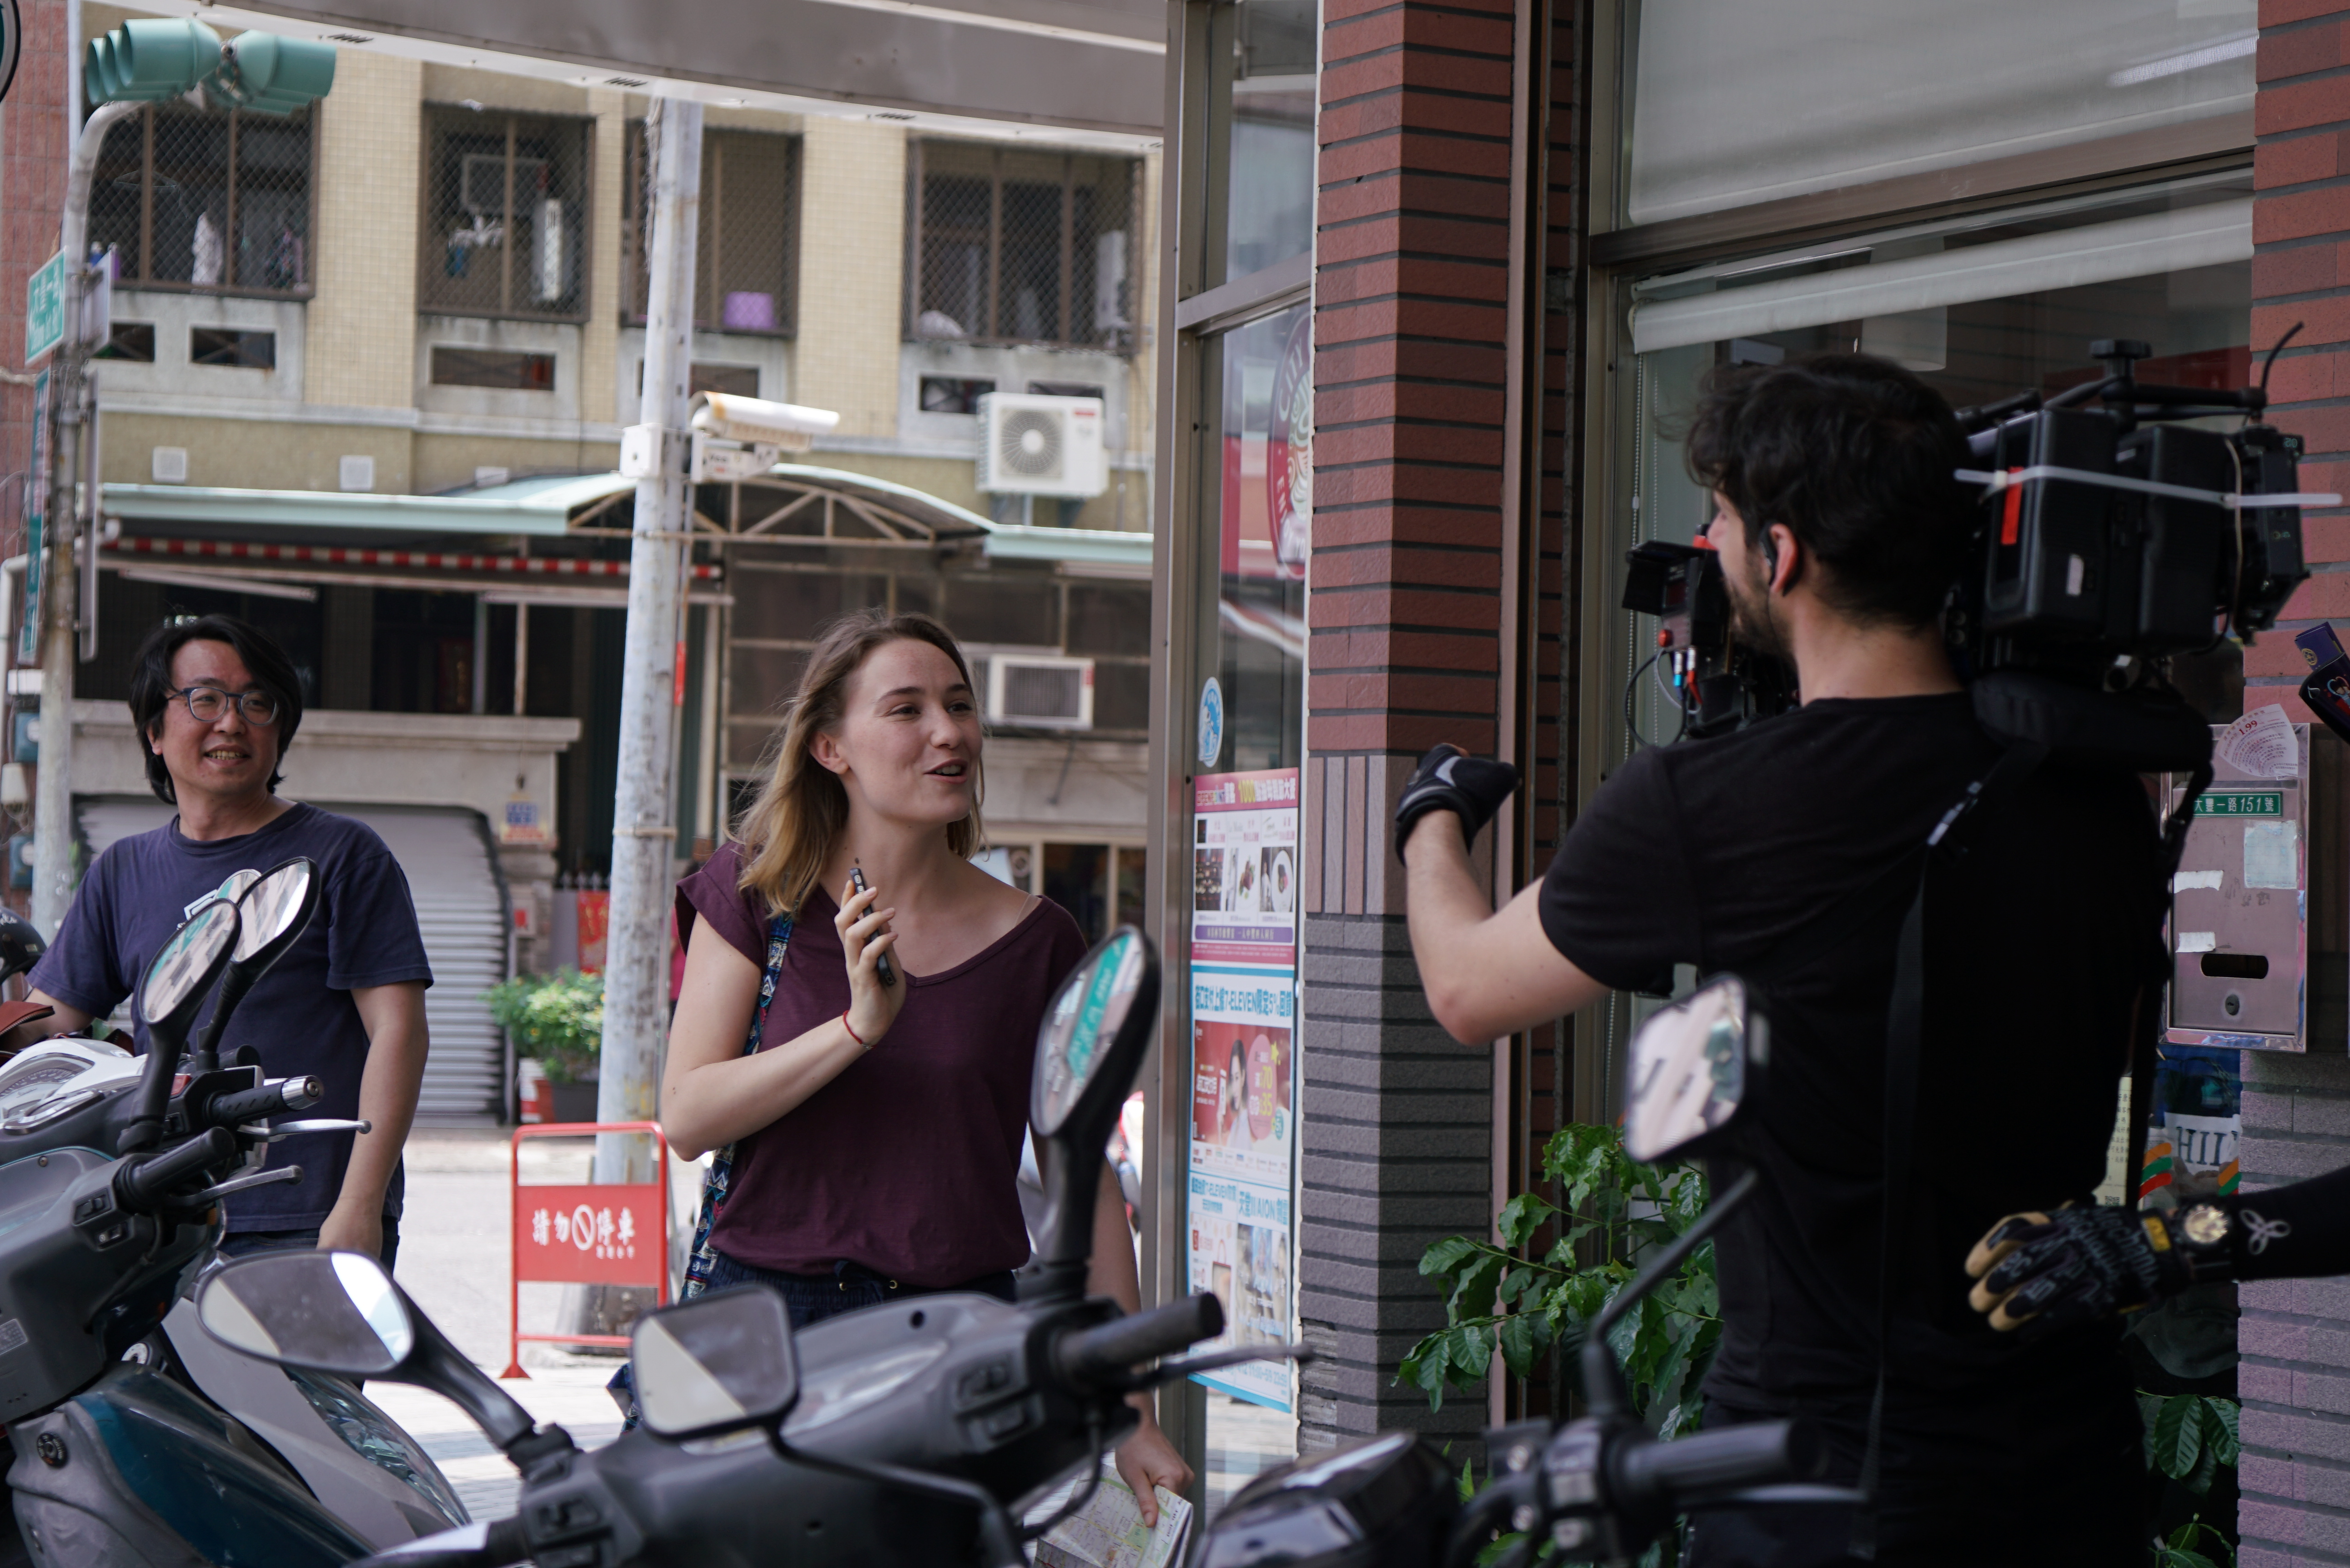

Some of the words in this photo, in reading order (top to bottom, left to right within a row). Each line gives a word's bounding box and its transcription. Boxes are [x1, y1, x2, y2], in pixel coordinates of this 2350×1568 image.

[1278, 337, 1304, 422] CITY
[2239, 720, 2257, 735] 1.99
[2194, 796, 2274, 812] 大豐一路151號
[532, 1208, 571, 1246] 請勿
[596, 1206, 636, 1246] 停車
